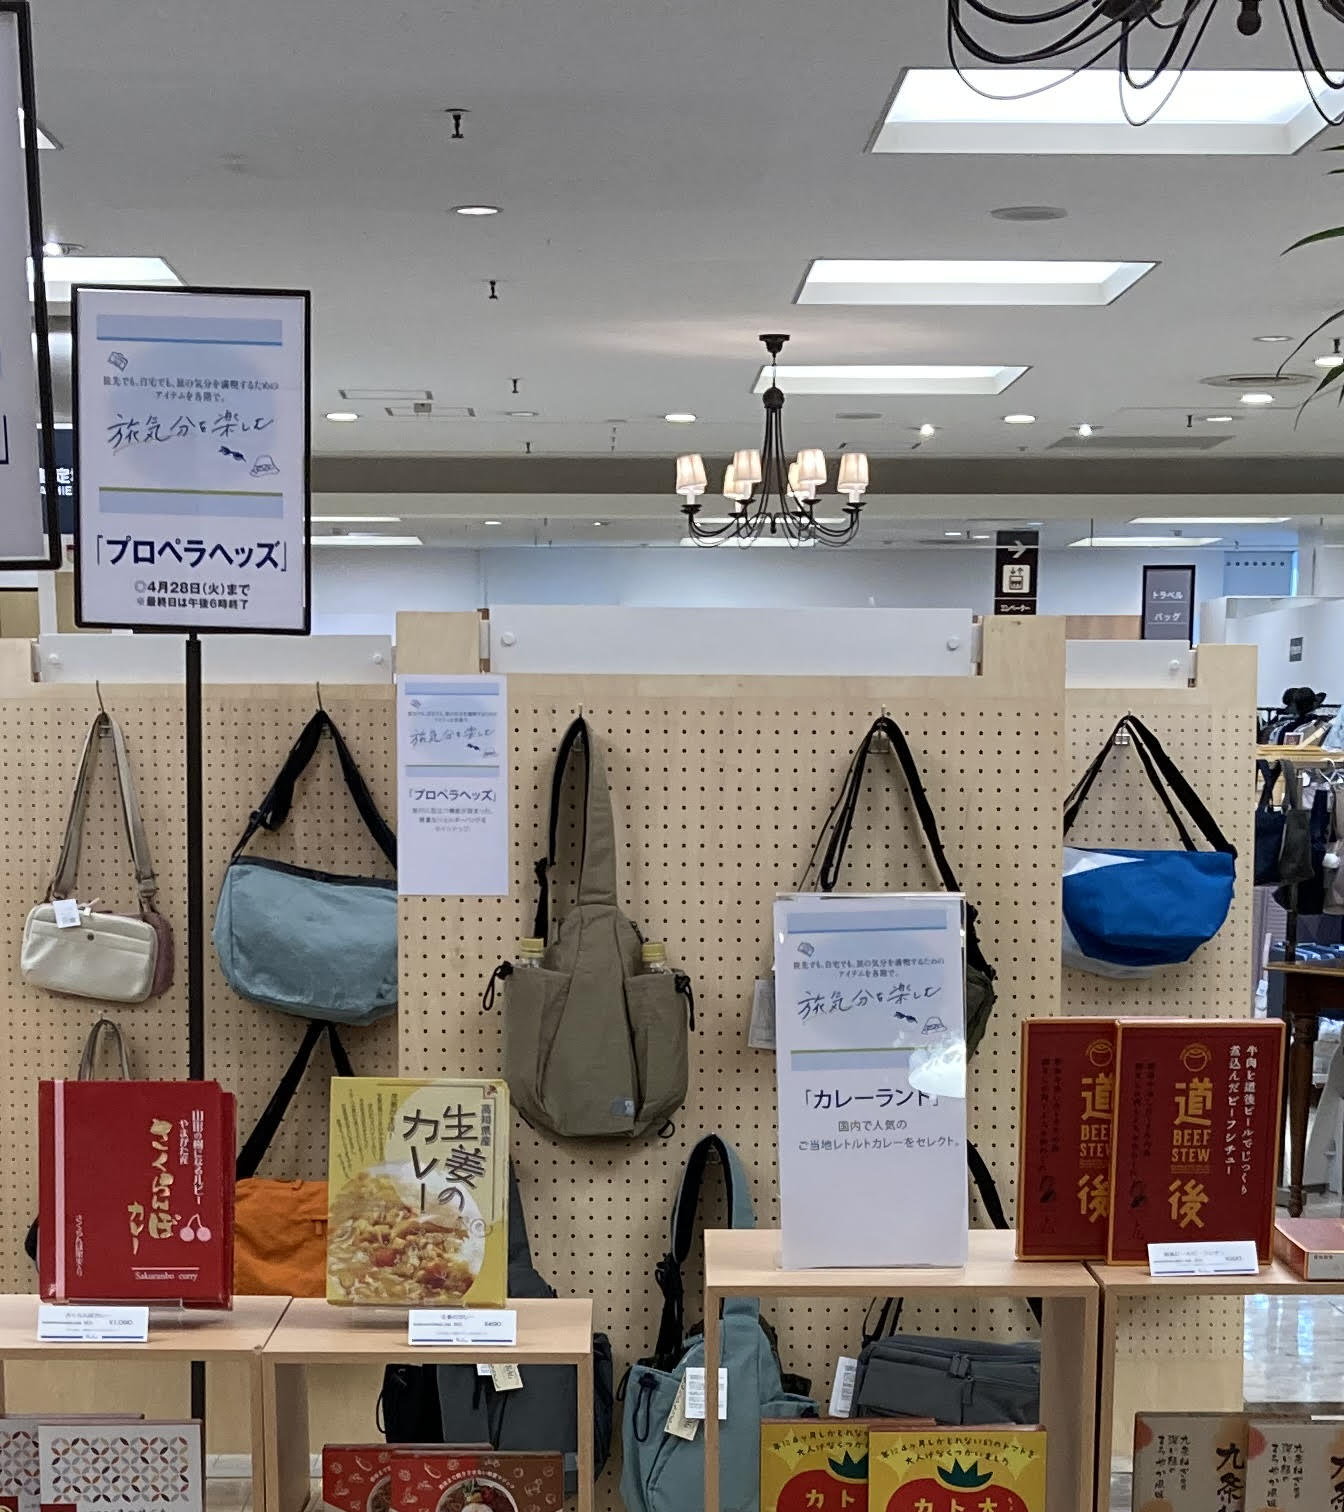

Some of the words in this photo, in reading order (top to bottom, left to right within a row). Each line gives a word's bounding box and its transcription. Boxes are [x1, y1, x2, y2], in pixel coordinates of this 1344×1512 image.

[107, 409, 274, 449] 旅気分を楽しむ
[97, 534, 287, 572] 「プロペラヘッズ」
[408, 788, 496, 802] 「プロペラヘッズ」
[838, 1119, 907, 1132] 国内で人気の
[1081, 1125, 1111, 1141] BEE
[1173, 1130, 1210, 1145] BEEF
[403, 1109, 439, 1213] カレー
[438, 1104, 486, 1212] 生姜の
[1171, 1149, 1210, 1162] STEW
[135, 1272, 174, 1280] Sakuranbo
[179, 1273, 198, 1282] curry
